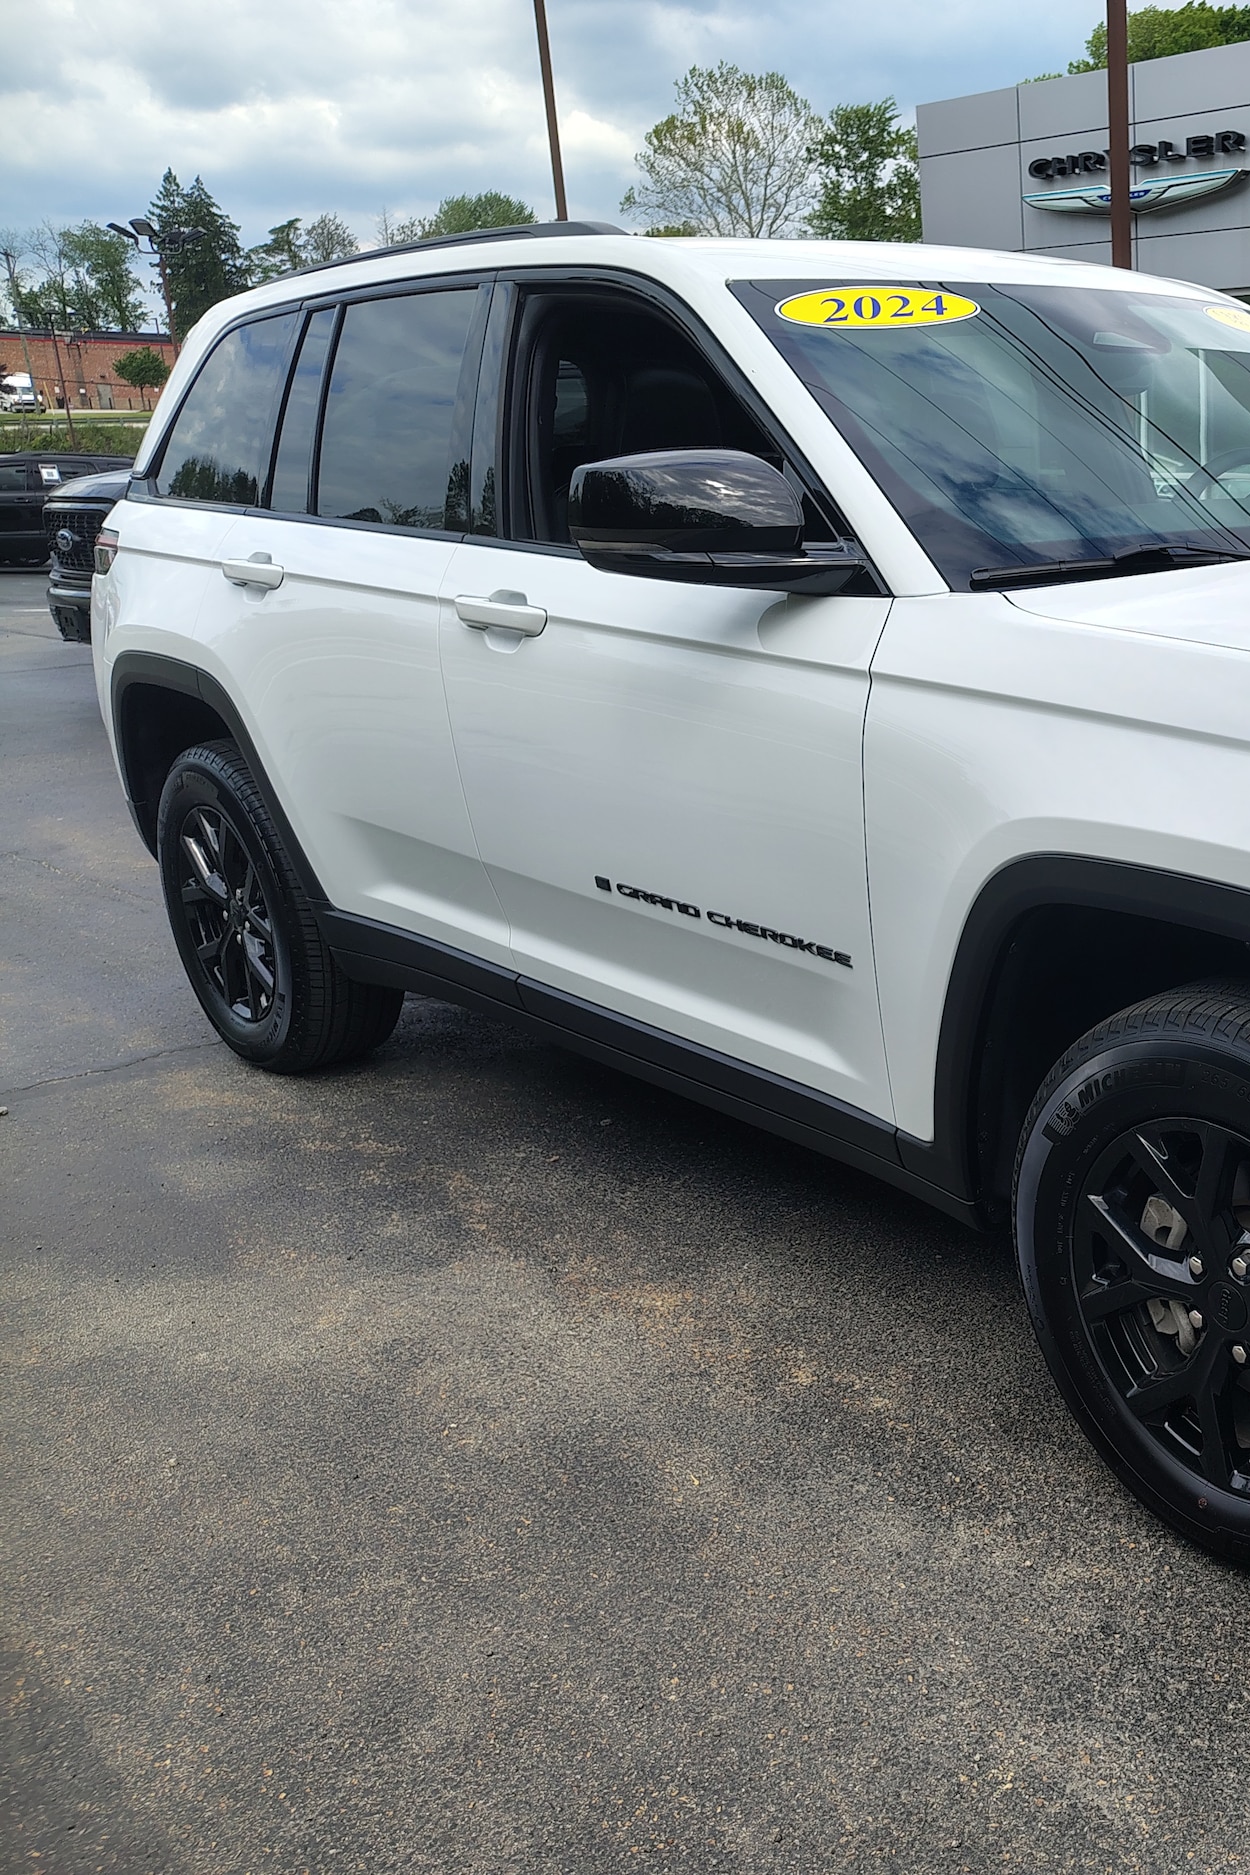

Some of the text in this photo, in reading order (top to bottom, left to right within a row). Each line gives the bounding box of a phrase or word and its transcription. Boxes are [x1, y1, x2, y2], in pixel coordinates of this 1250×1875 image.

[1028, 130, 1247, 180] CHRSLER
[820, 294, 948, 323] 2024
[616, 882, 854, 969] GRAND CHEROKEE
